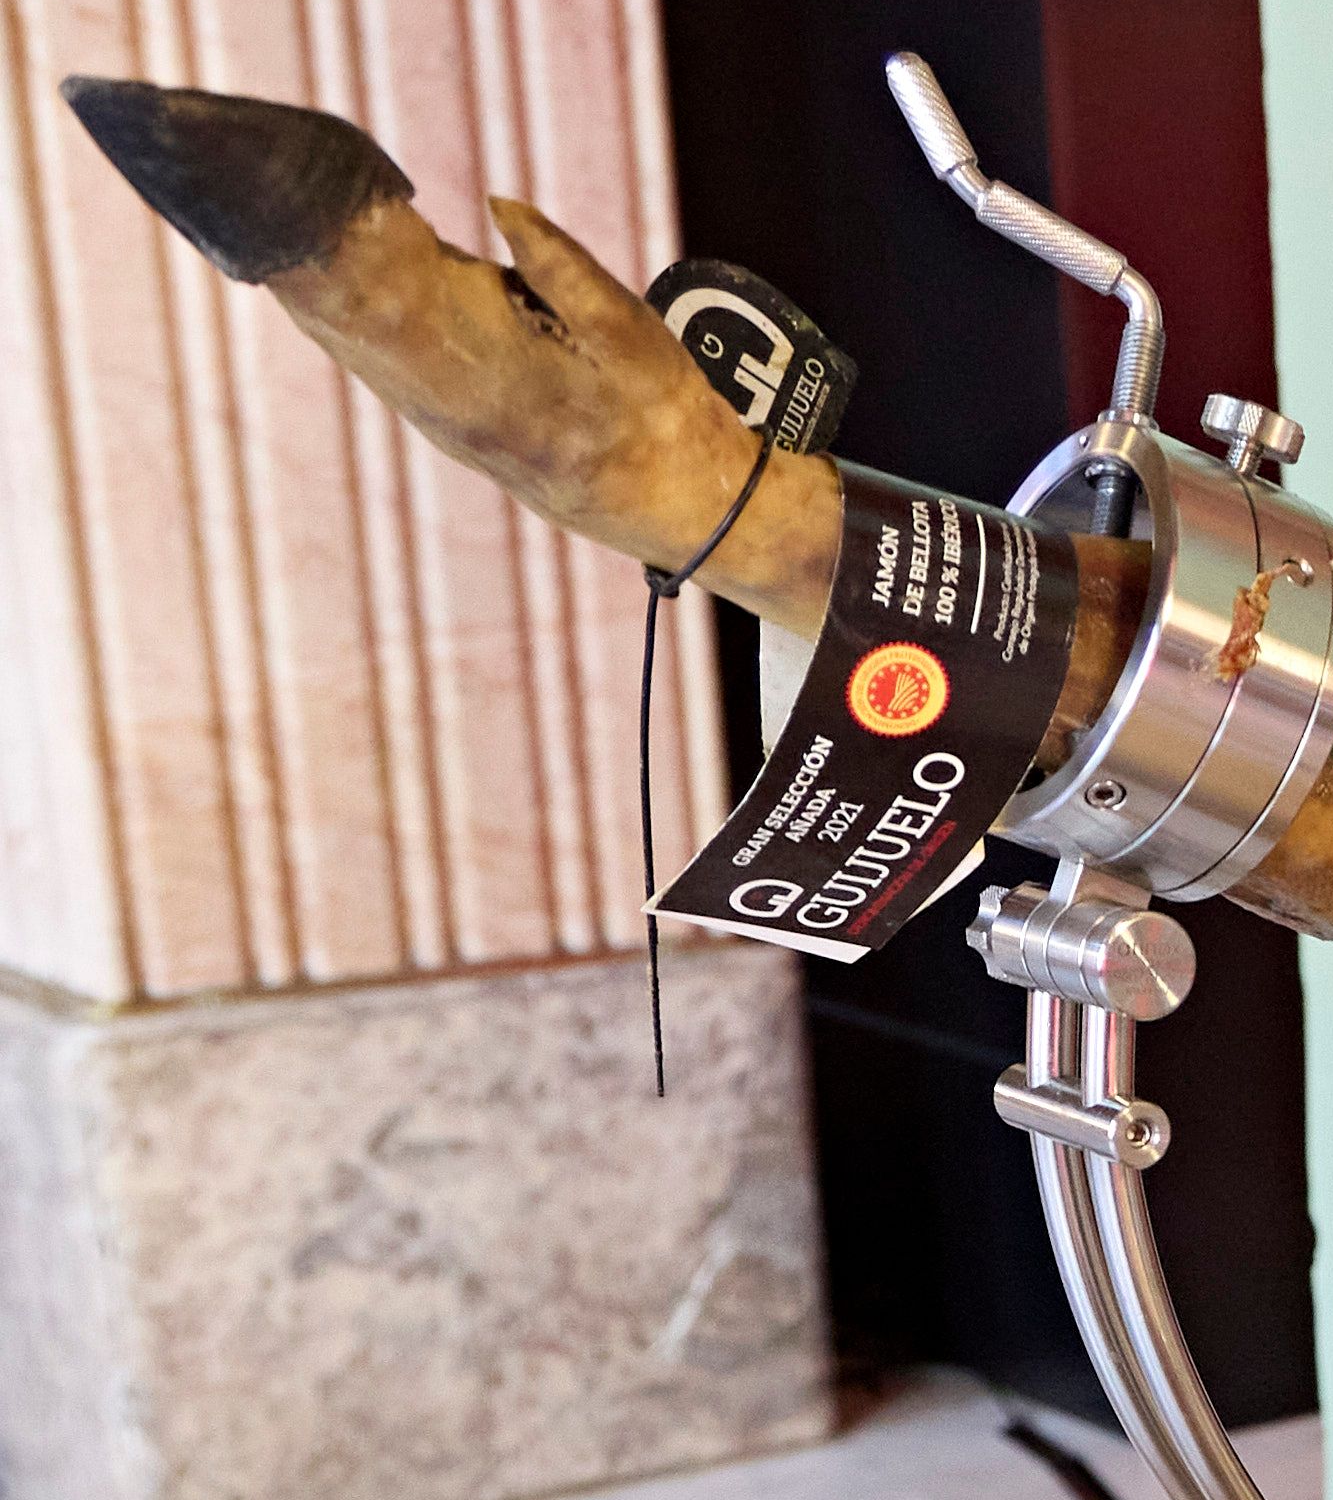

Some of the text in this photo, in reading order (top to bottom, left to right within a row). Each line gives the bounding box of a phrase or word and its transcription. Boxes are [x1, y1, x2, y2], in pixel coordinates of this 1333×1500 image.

[872, 524, 899, 609] JAMÓN
[903, 501, 931, 617] DE BELLOTA
[935, 586, 957, 625] 100
[732, 734, 834, 866] GRAN SELECCIÓN
[785, 788, 836, 843] AÑADA
[796, 752, 965, 928] GUIJUELO
[817, 801, 865, 843] 2021
